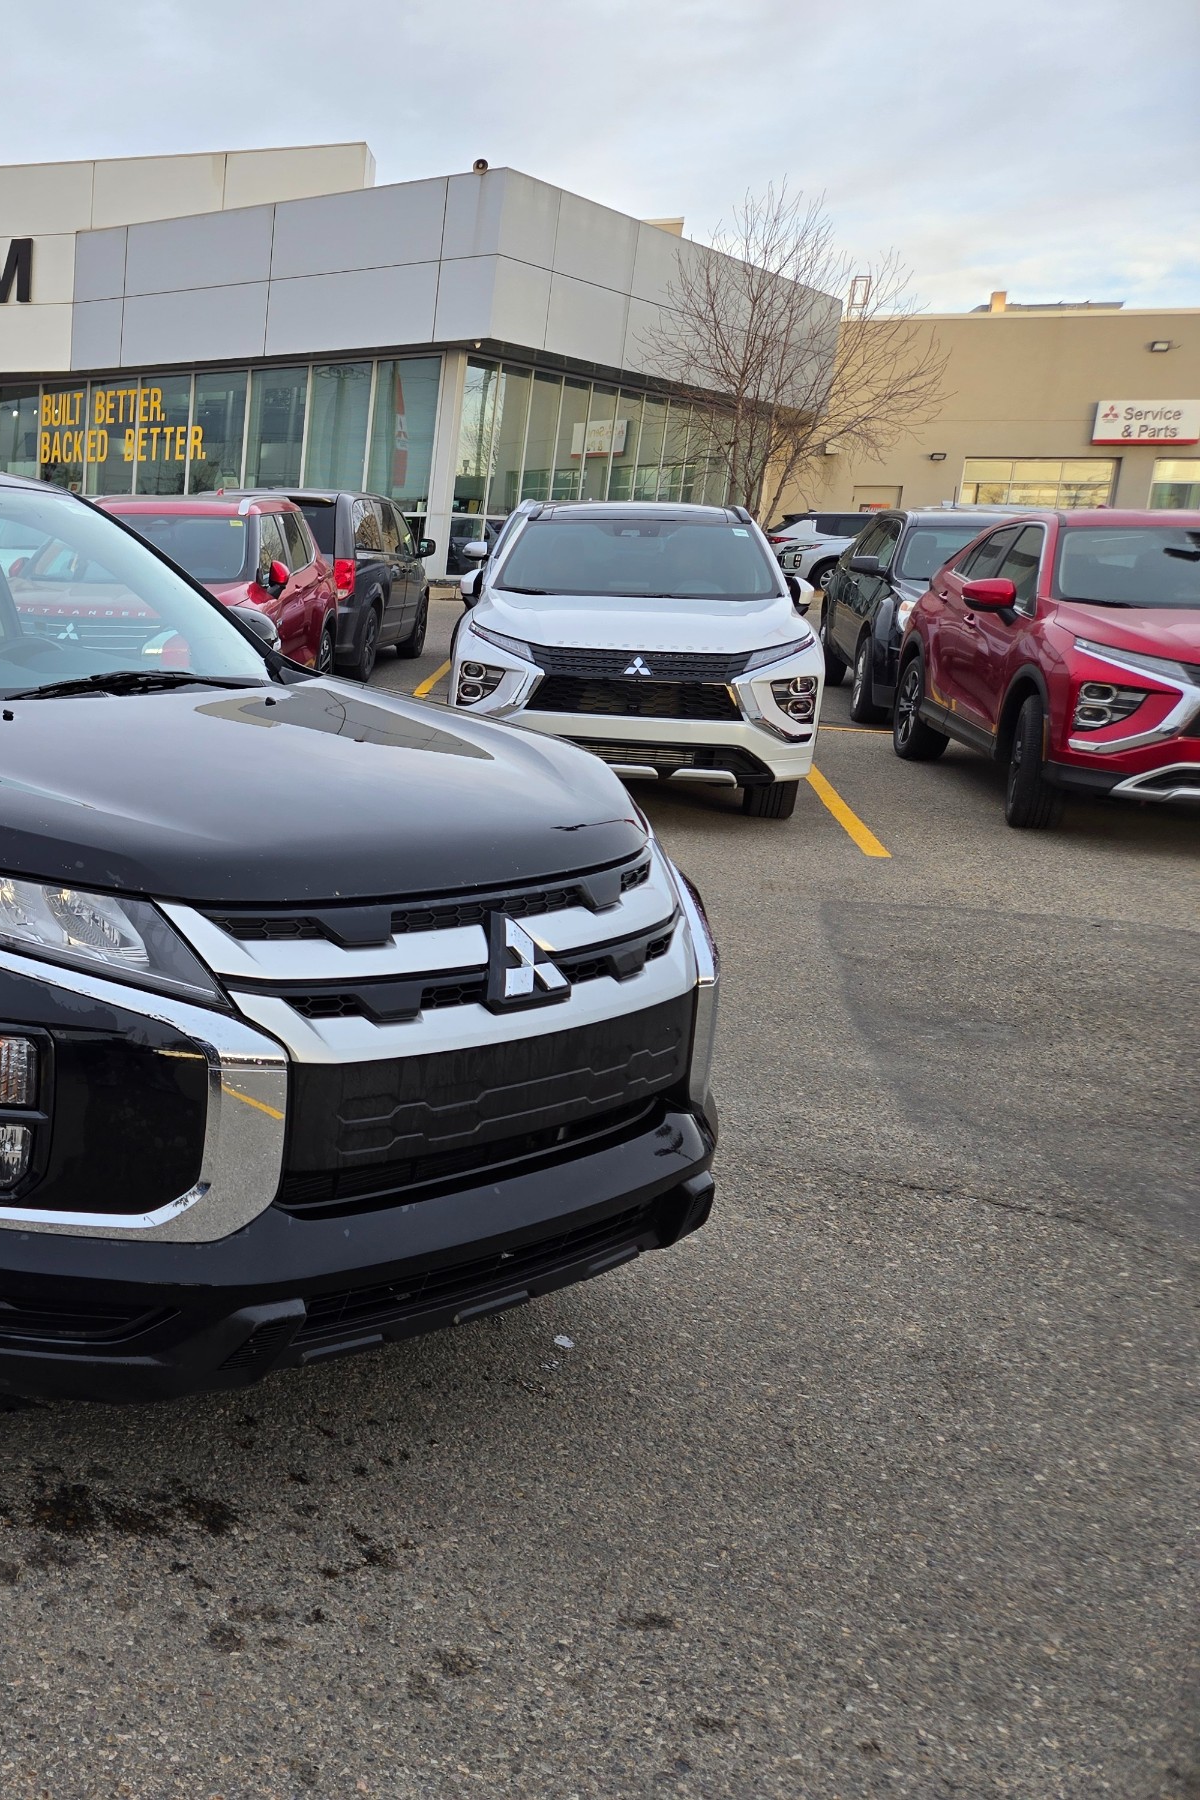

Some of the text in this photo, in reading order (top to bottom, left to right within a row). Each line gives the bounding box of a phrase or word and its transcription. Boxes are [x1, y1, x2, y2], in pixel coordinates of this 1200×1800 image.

[41, 387, 166, 427] BUILT BETTER.
[1123, 407, 1182, 421] Service
[1121, 424, 1178, 438] & Parts
[40, 425, 207, 464] BACKED BETTER.
